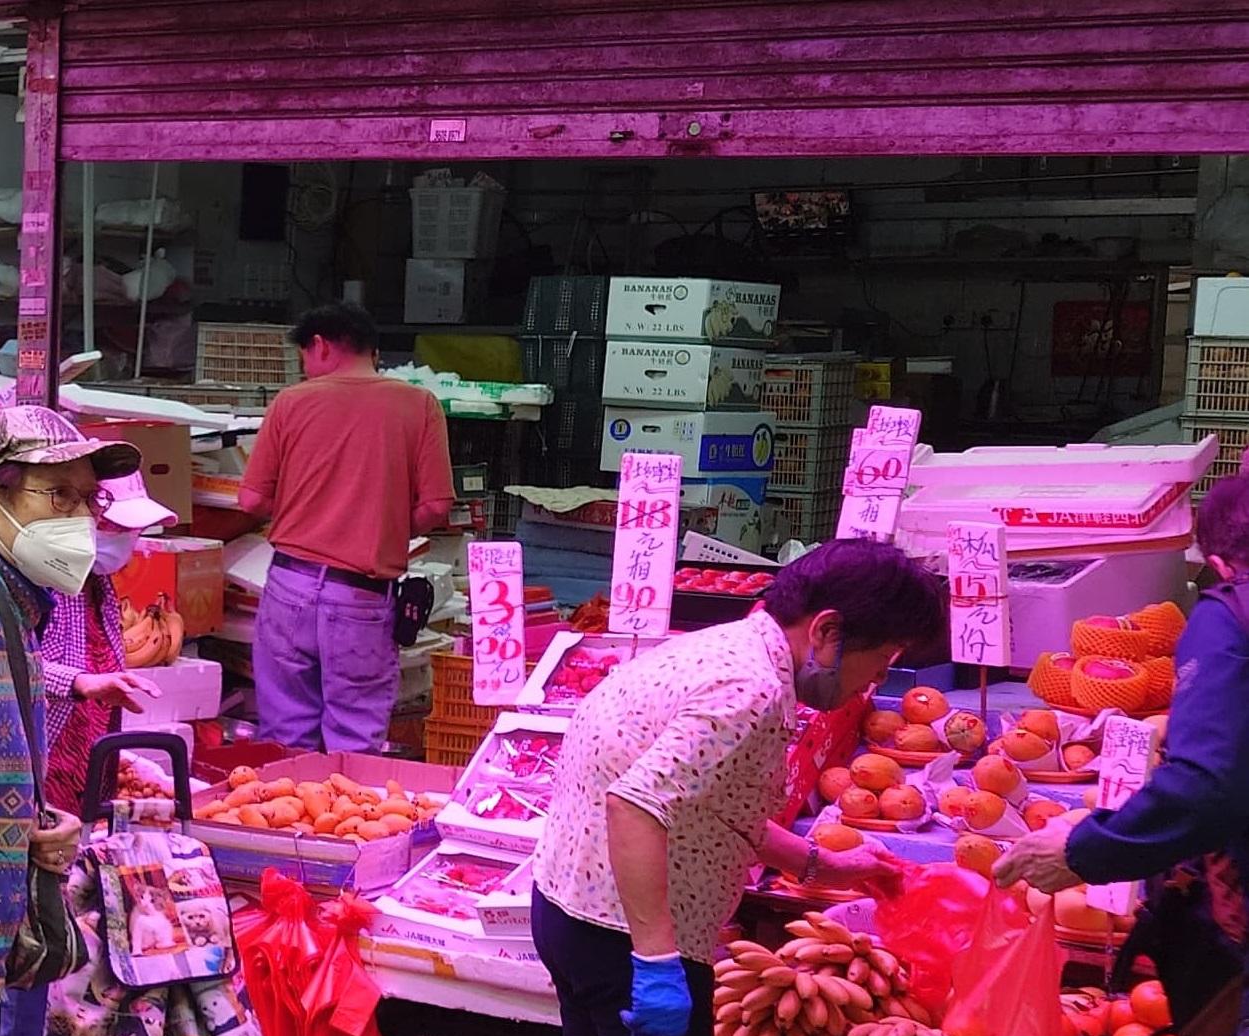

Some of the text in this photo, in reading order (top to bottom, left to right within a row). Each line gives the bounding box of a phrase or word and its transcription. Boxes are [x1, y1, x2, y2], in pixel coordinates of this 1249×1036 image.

[624, 284, 673, 293] BANANAS
[735, 292, 777, 306] BANANAS
[652, 323, 662, 331] 22
[666, 323, 685, 332] LBS
[621, 348, 674, 356] BANANAS
[731, 357, 764, 369] BANANAS
[652, 387, 662, 396] 22
[666, 388, 686, 397] LBS
[855, 449, 903, 486] 60
[478, 580, 515, 626] 3
[613, 582, 657, 616] 90
[959, 623, 999, 663] 份
